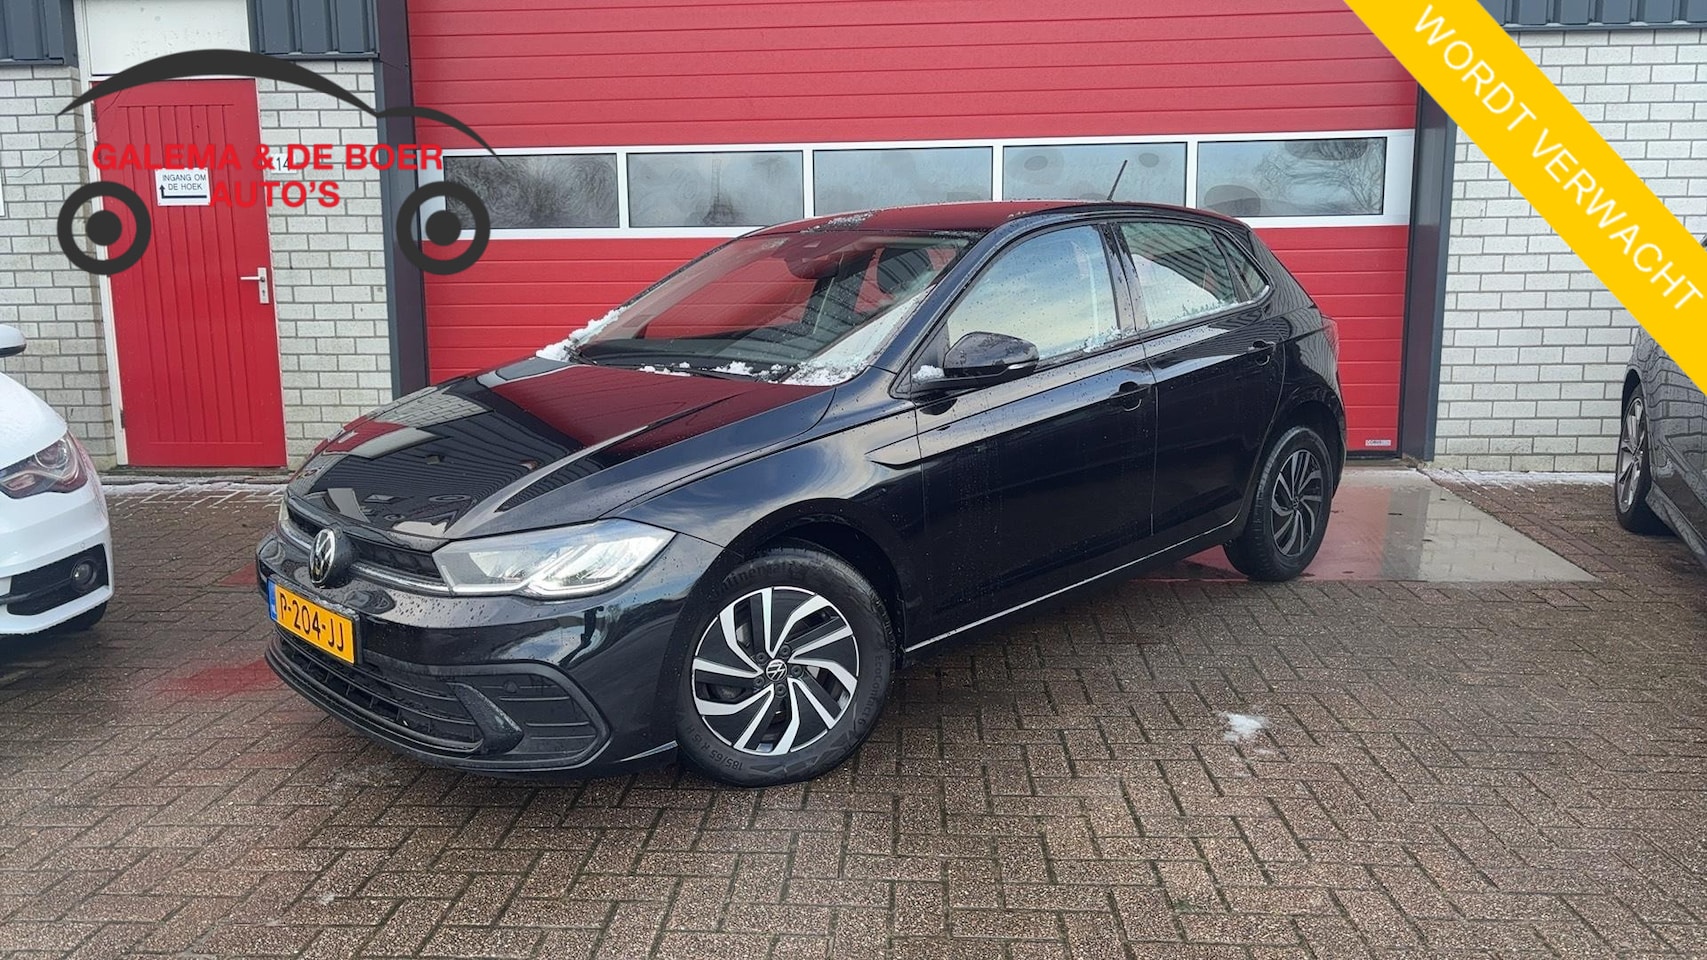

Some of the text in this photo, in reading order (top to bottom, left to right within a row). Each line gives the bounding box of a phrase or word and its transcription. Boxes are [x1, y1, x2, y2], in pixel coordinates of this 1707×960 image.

[162, 173, 207, 182] INGANG OM
[167, 183, 203, 191] DE HOEK
[278, 592, 345, 653] P-204-JJ
[709, 749, 743, 771] 185/65
